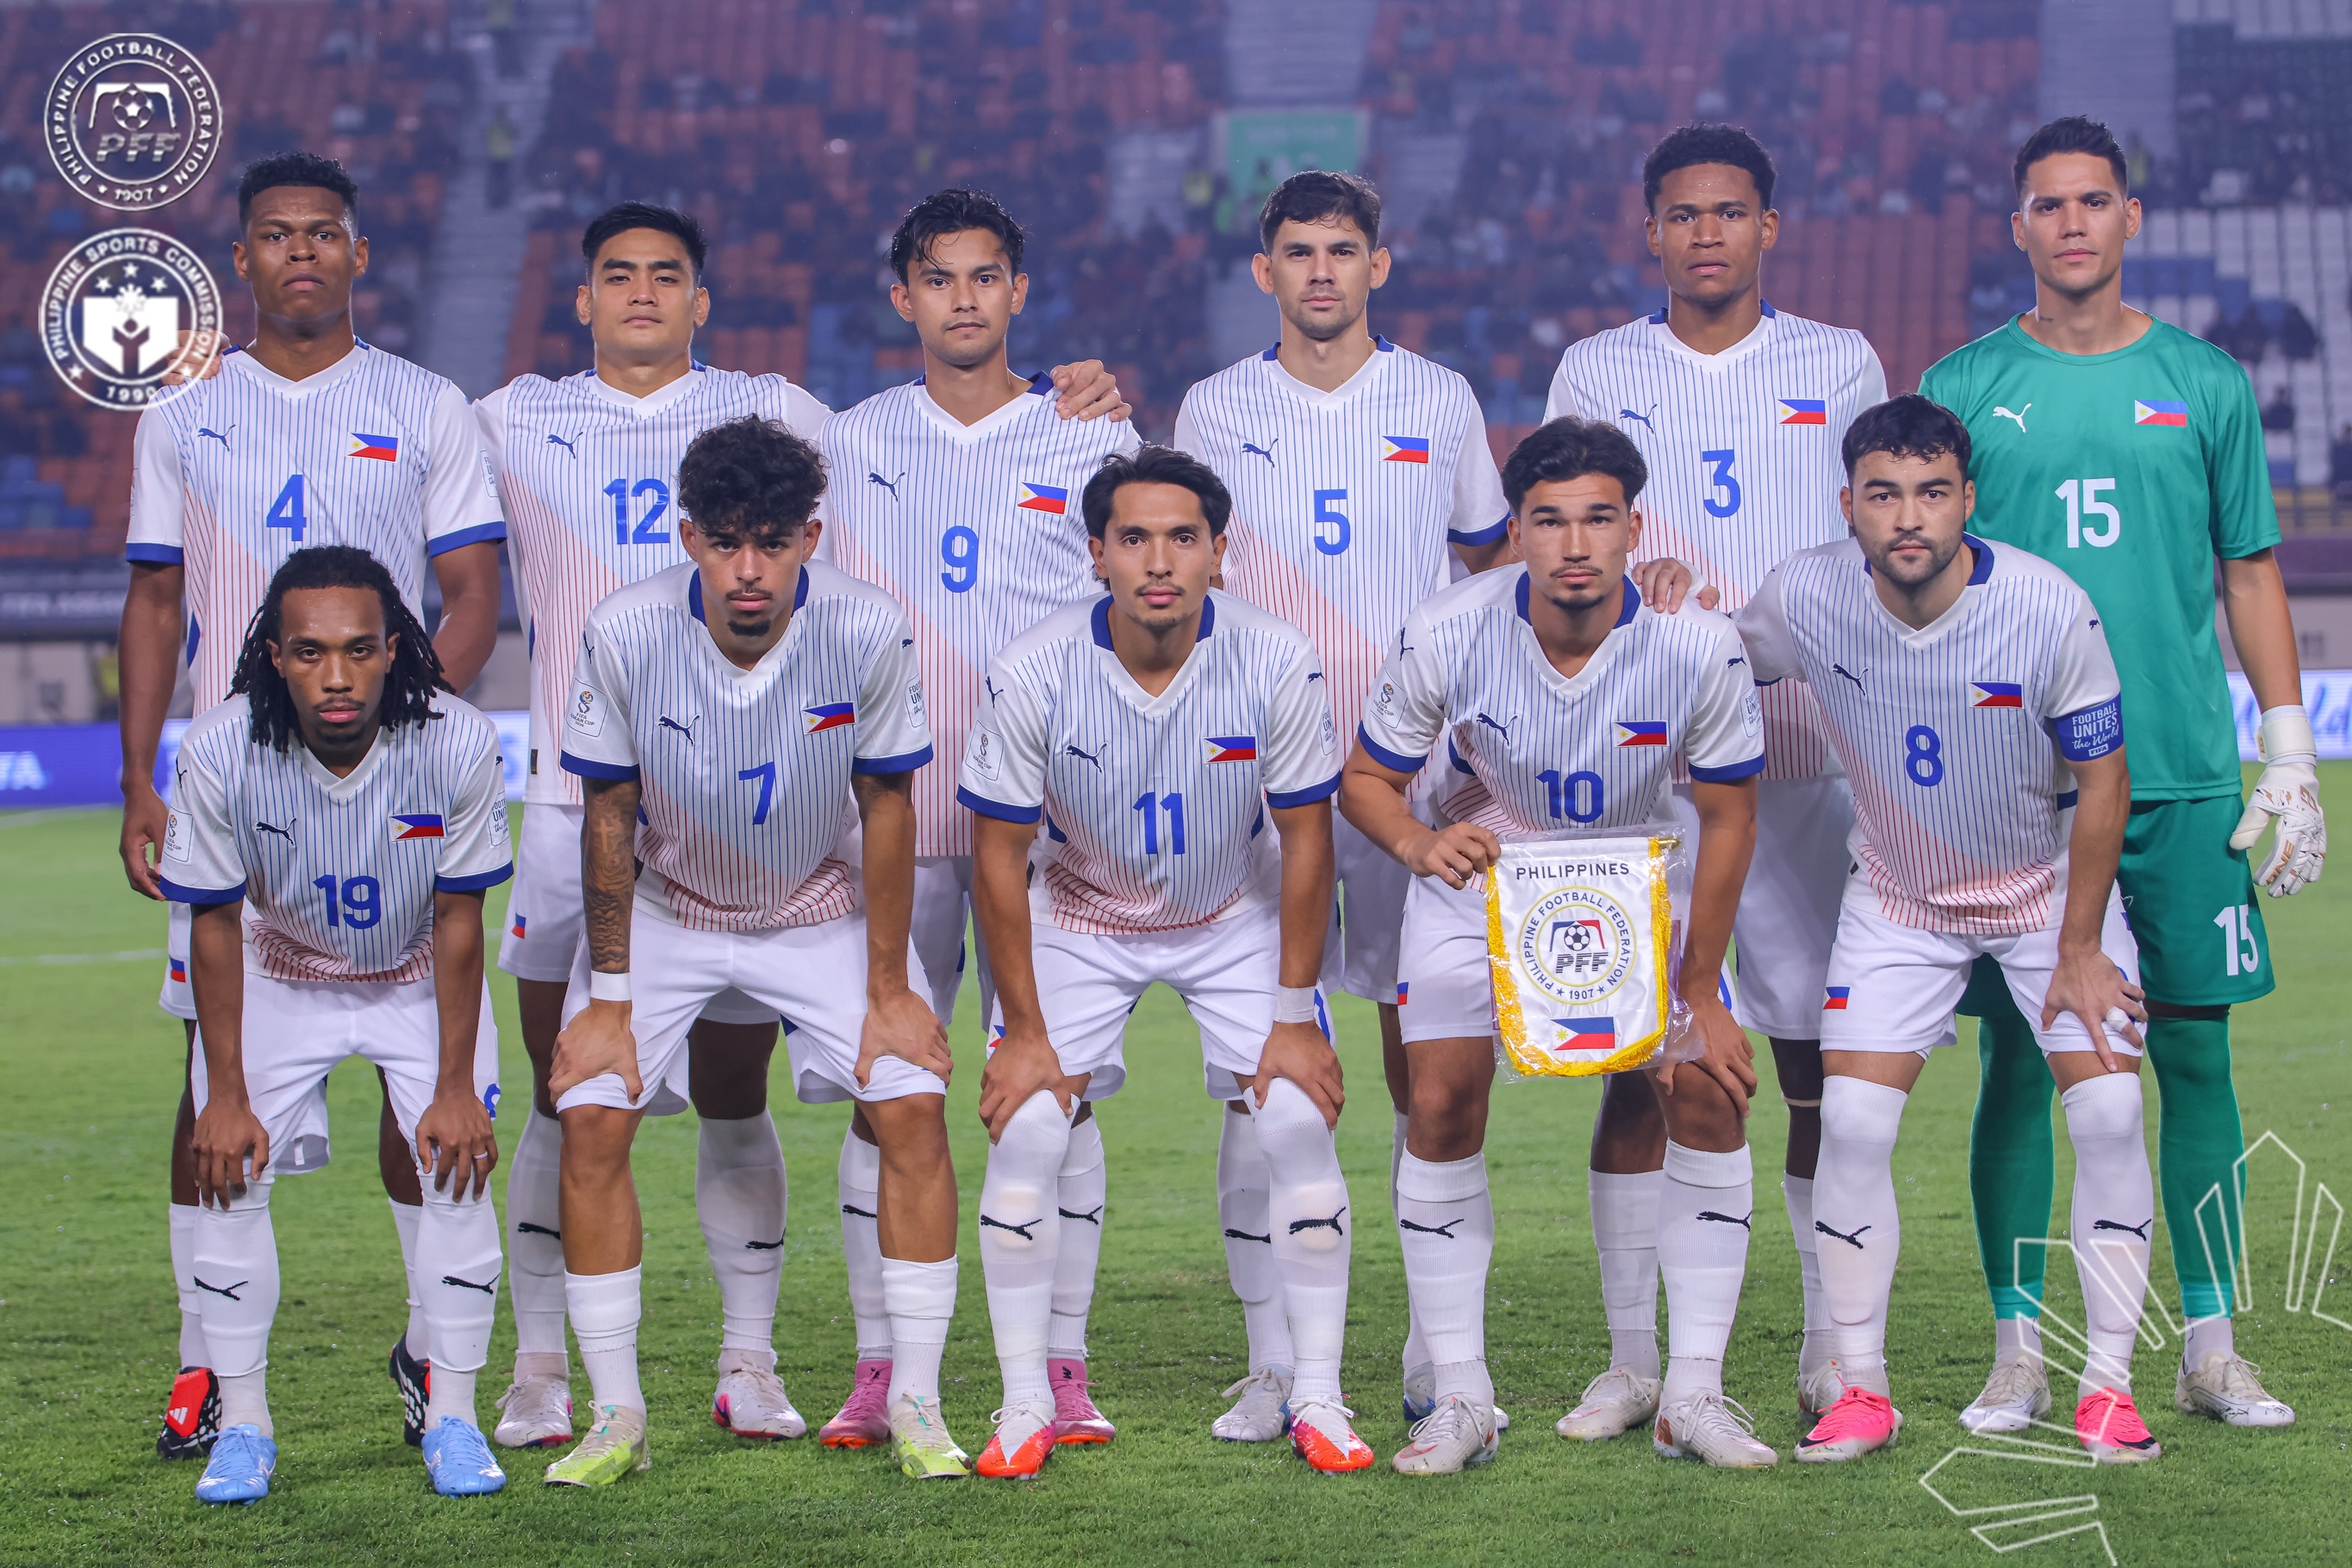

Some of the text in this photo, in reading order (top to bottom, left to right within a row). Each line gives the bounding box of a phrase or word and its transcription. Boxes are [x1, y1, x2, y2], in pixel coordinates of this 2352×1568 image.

[266, 475, 307, 542] 4
[603, 478, 671, 545] 12
[1702, 449, 1741, 519] 3
[2055, 478, 2120, 548] 15
[1314, 488, 1351, 556] 5
[941, 526, 979, 593] 9
[2071, 724, 2119, 750] the World
[2072, 702, 2117, 725] FOOTBALL
[2073, 712, 2118, 738] UNITES
[1907, 725, 1944, 787] 8
[2089, 744, 2108, 756] FIFA
[738, 762, 776, 824] 7
[1133, 792, 1185, 855] 11
[1535, 769, 1603, 823] 10
[314, 874, 381, 929] 19
[1516, 862, 1630, 880] PHILIPPINES
[1524, 892, 1631, 991] PHILIPPINE FOOTBALL FEDERATION
[1555, 951, 1609, 974] PFF
[2212, 905, 2258, 975] 15
[1569, 988, 1596, 999] 1907
